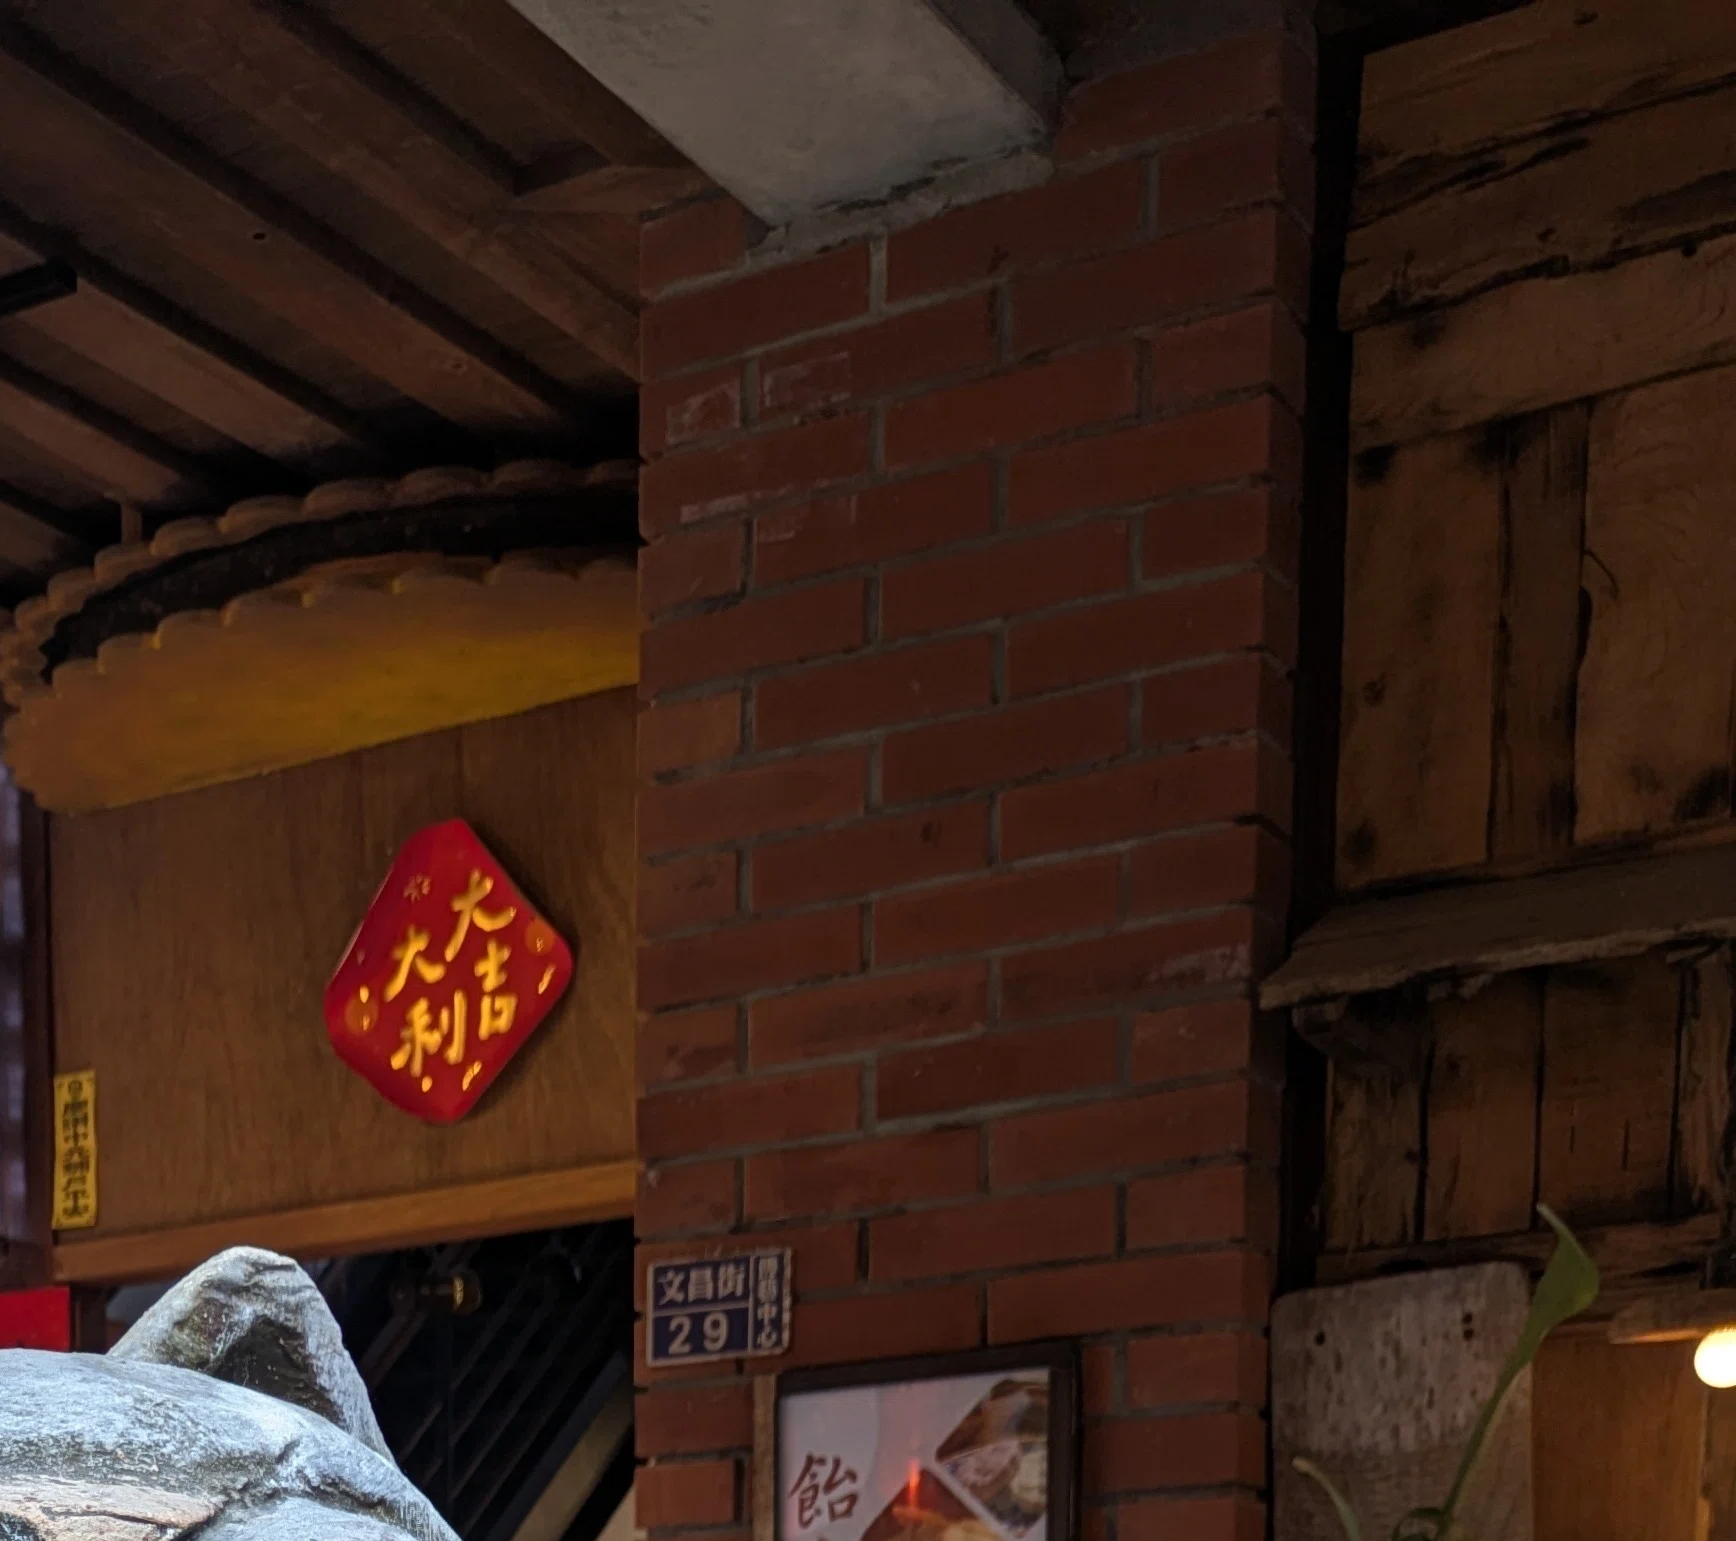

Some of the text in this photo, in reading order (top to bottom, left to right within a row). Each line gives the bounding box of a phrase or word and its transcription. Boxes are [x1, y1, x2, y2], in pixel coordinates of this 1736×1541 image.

[383, 925, 468, 1078] 大利
[445, 868, 516, 1041] 大吉
[657, 1262, 745, 1306] 文昌街
[667, 1311, 729, 1355] 29
